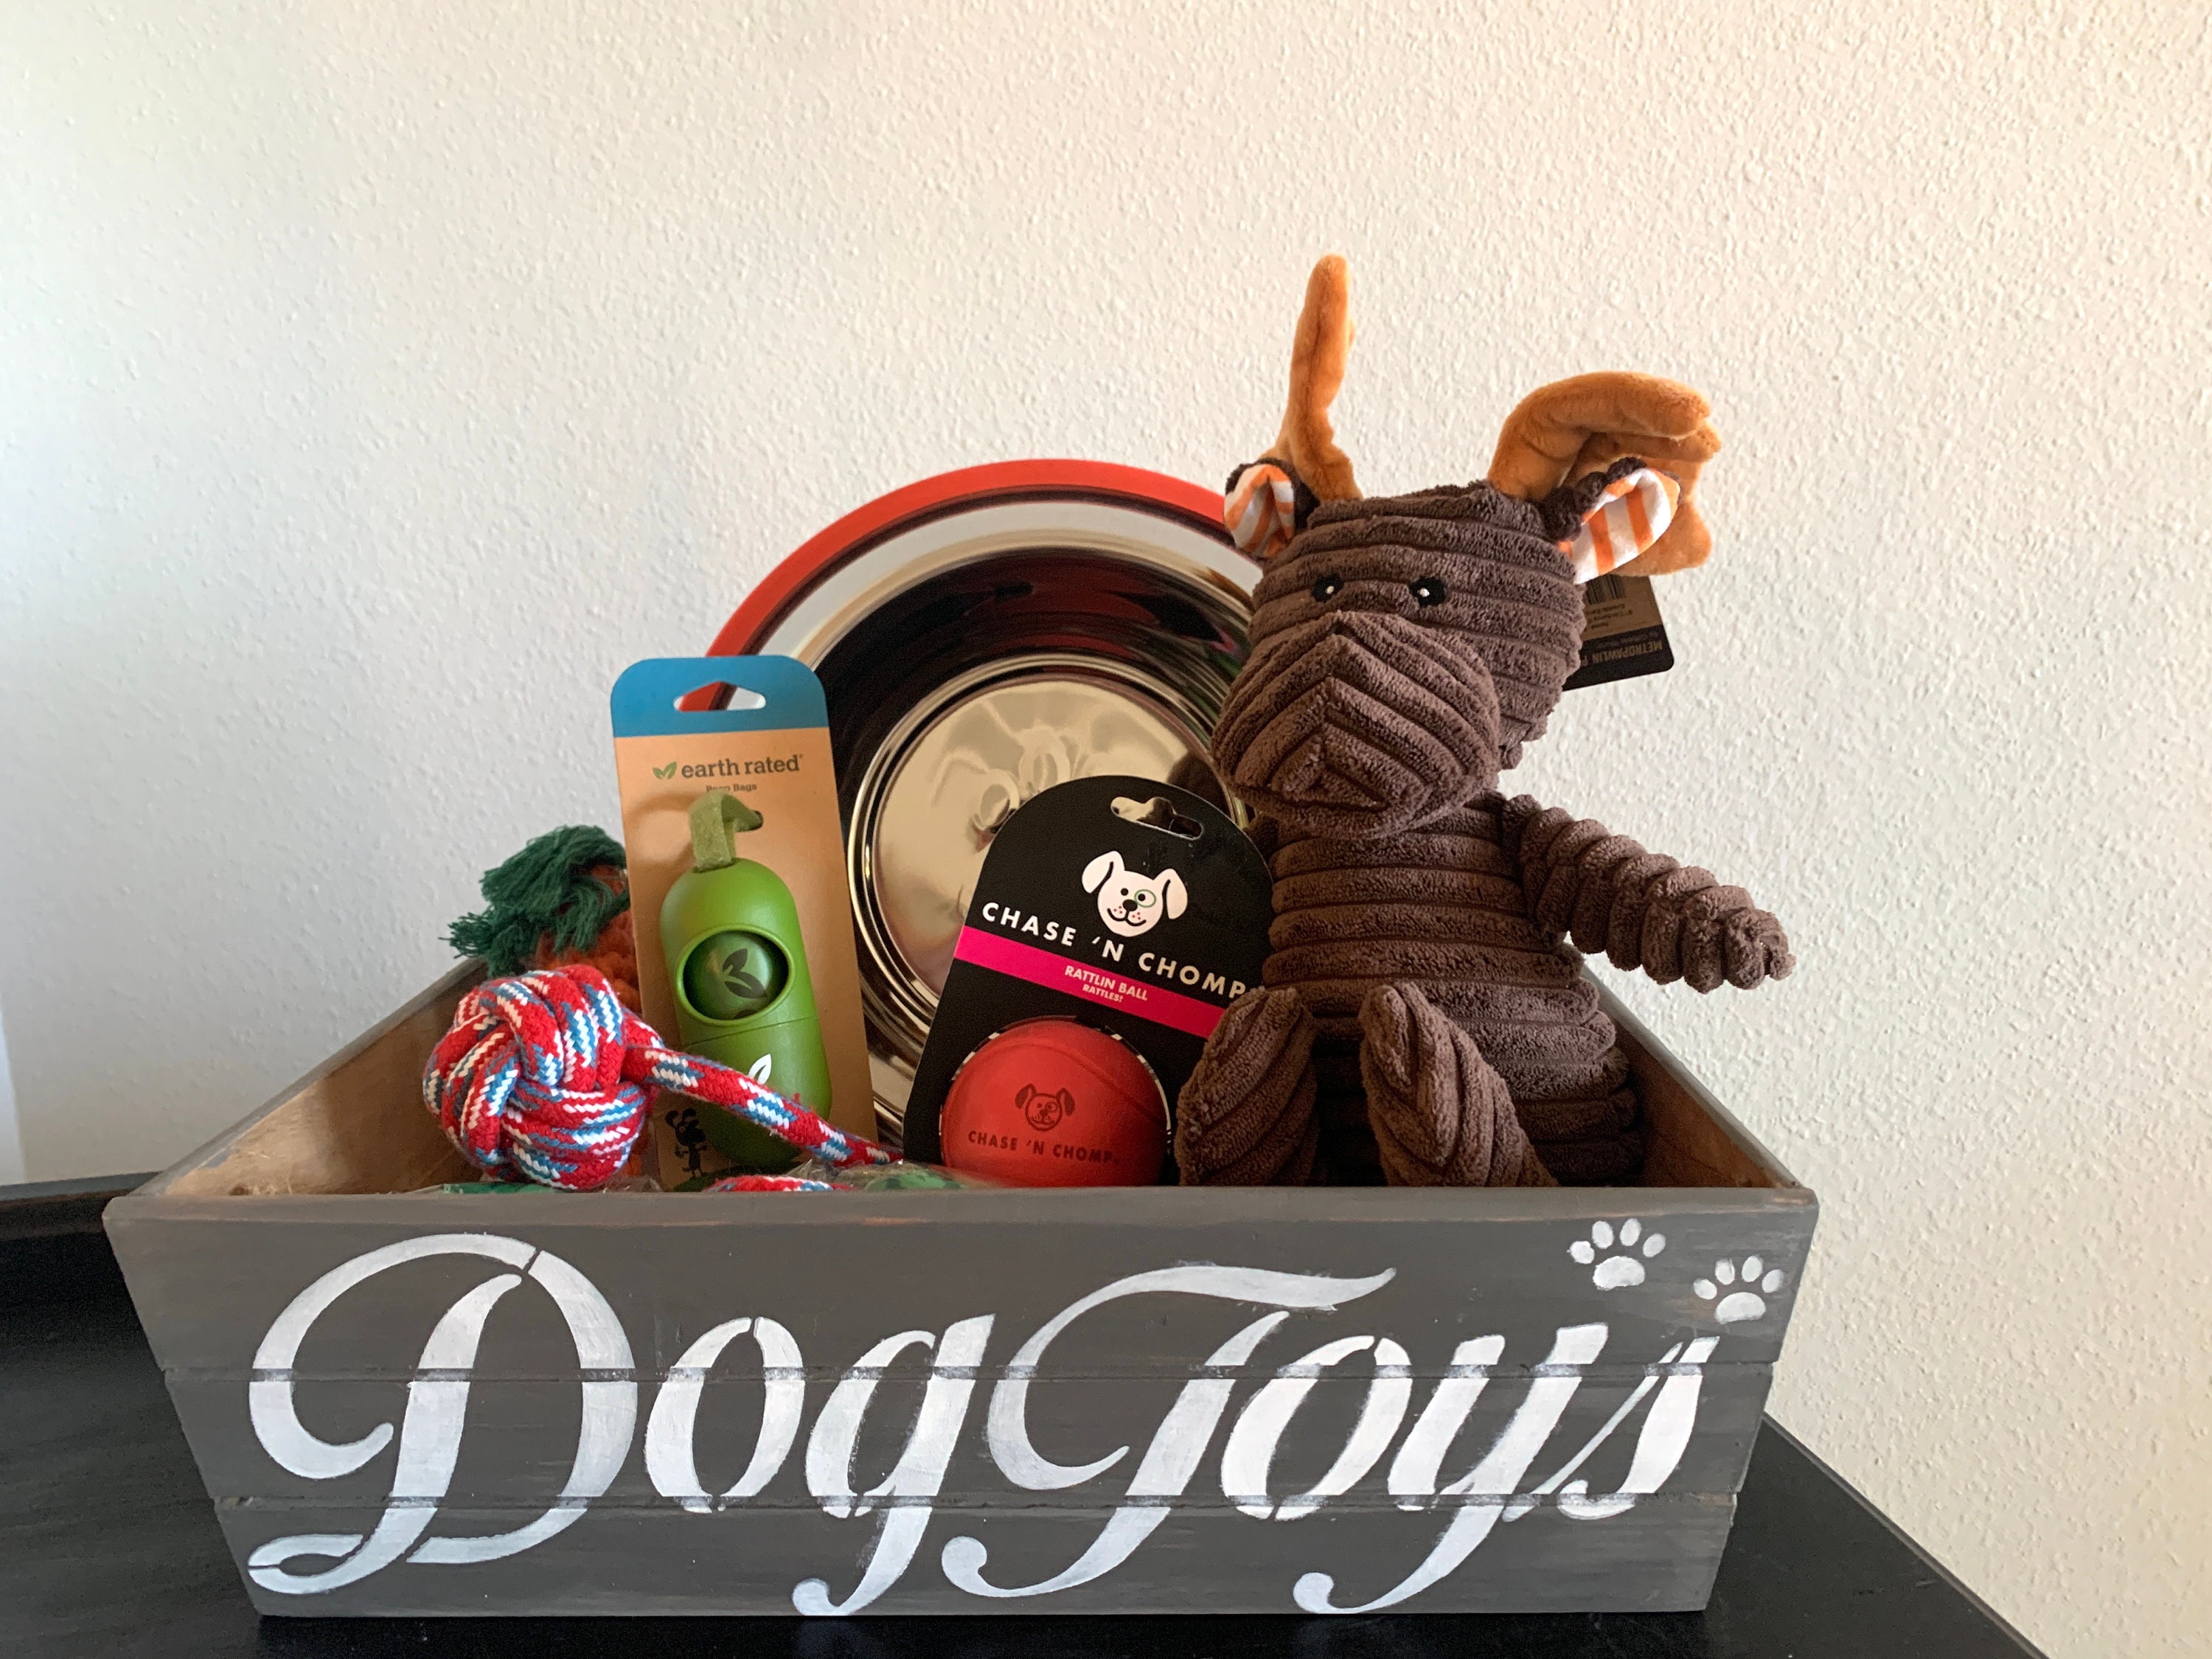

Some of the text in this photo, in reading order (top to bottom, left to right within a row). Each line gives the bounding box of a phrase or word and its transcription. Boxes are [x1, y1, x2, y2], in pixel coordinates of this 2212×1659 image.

[681, 755, 799, 778] earth rated
[733, 783, 757, 792] Bags
[981, 902, 1077, 947] CHASE
[1138, 952, 1247, 999] CHOMP
[1064, 964, 1148, 1001] RATTLIN BALL
[1082, 983, 1124, 1003] RATTLES!
[967, 1130, 1018, 1150] CHASE
[1053, 1144, 1113, 1164] CHOMP
[248, 1233, 1720, 1616] Dog Toys
